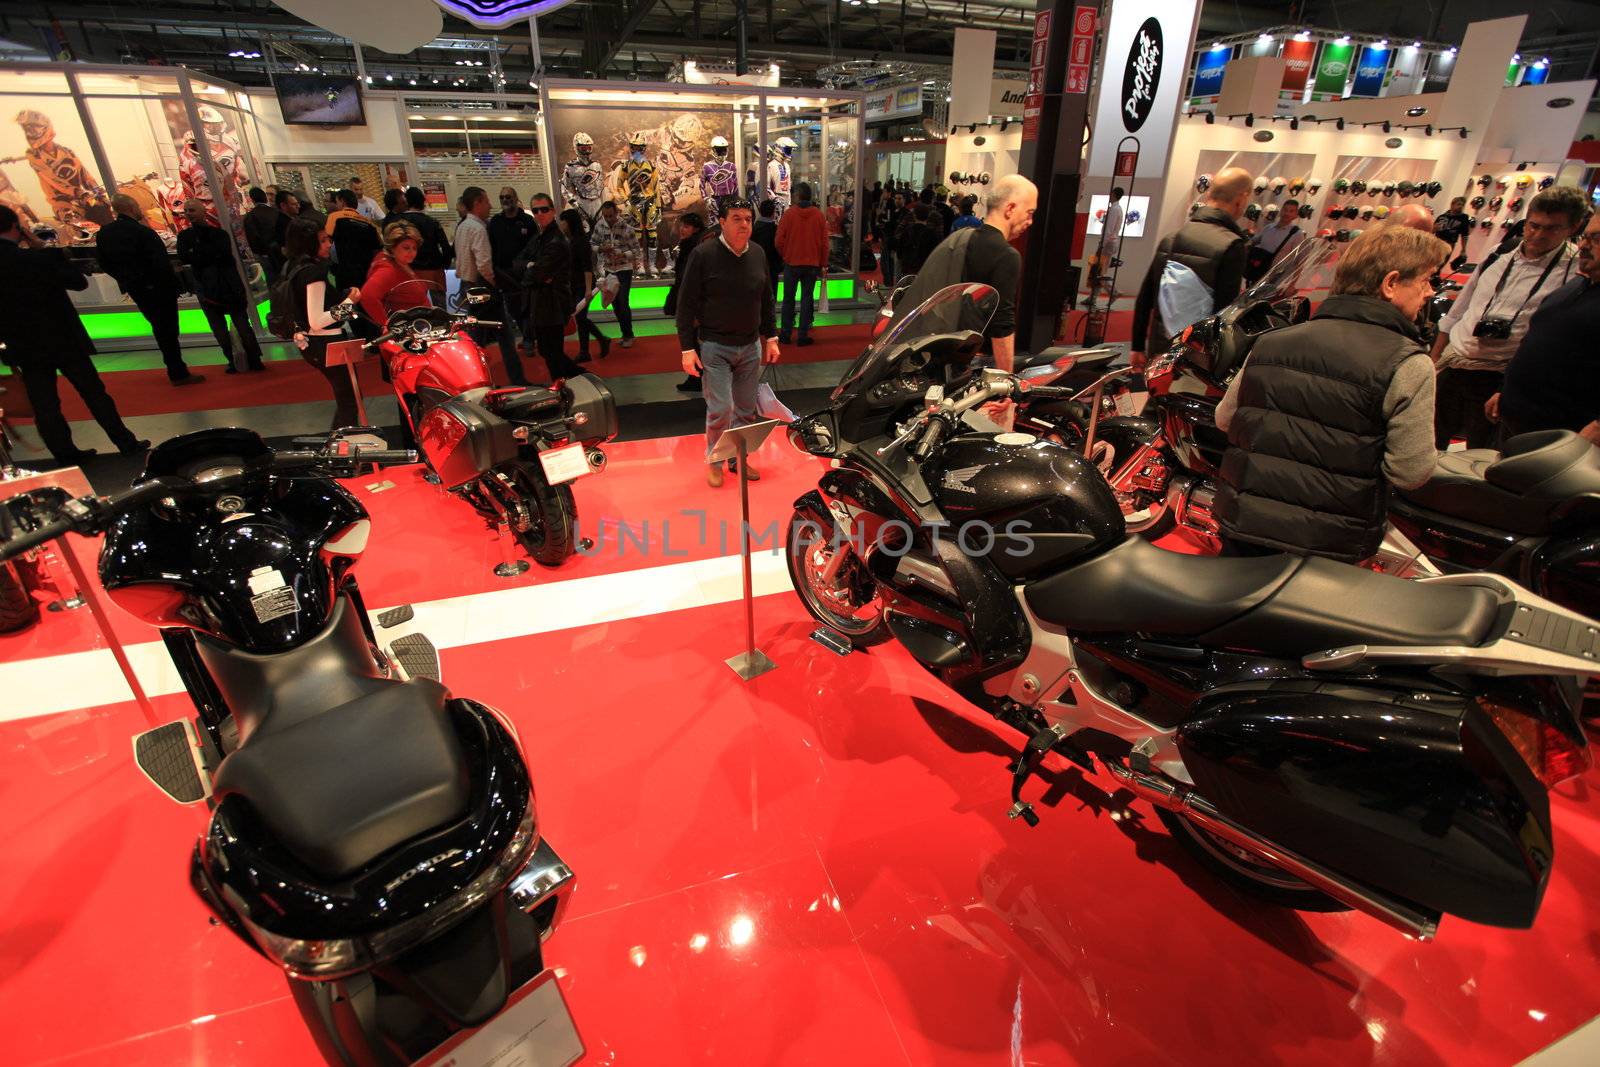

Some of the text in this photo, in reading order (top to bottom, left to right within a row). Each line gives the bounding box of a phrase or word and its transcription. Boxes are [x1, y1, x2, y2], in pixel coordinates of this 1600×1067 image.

[1125, 30, 1152, 119] Project
[943, 481, 977, 495] HONDA
[384, 848, 464, 893] HONDA
